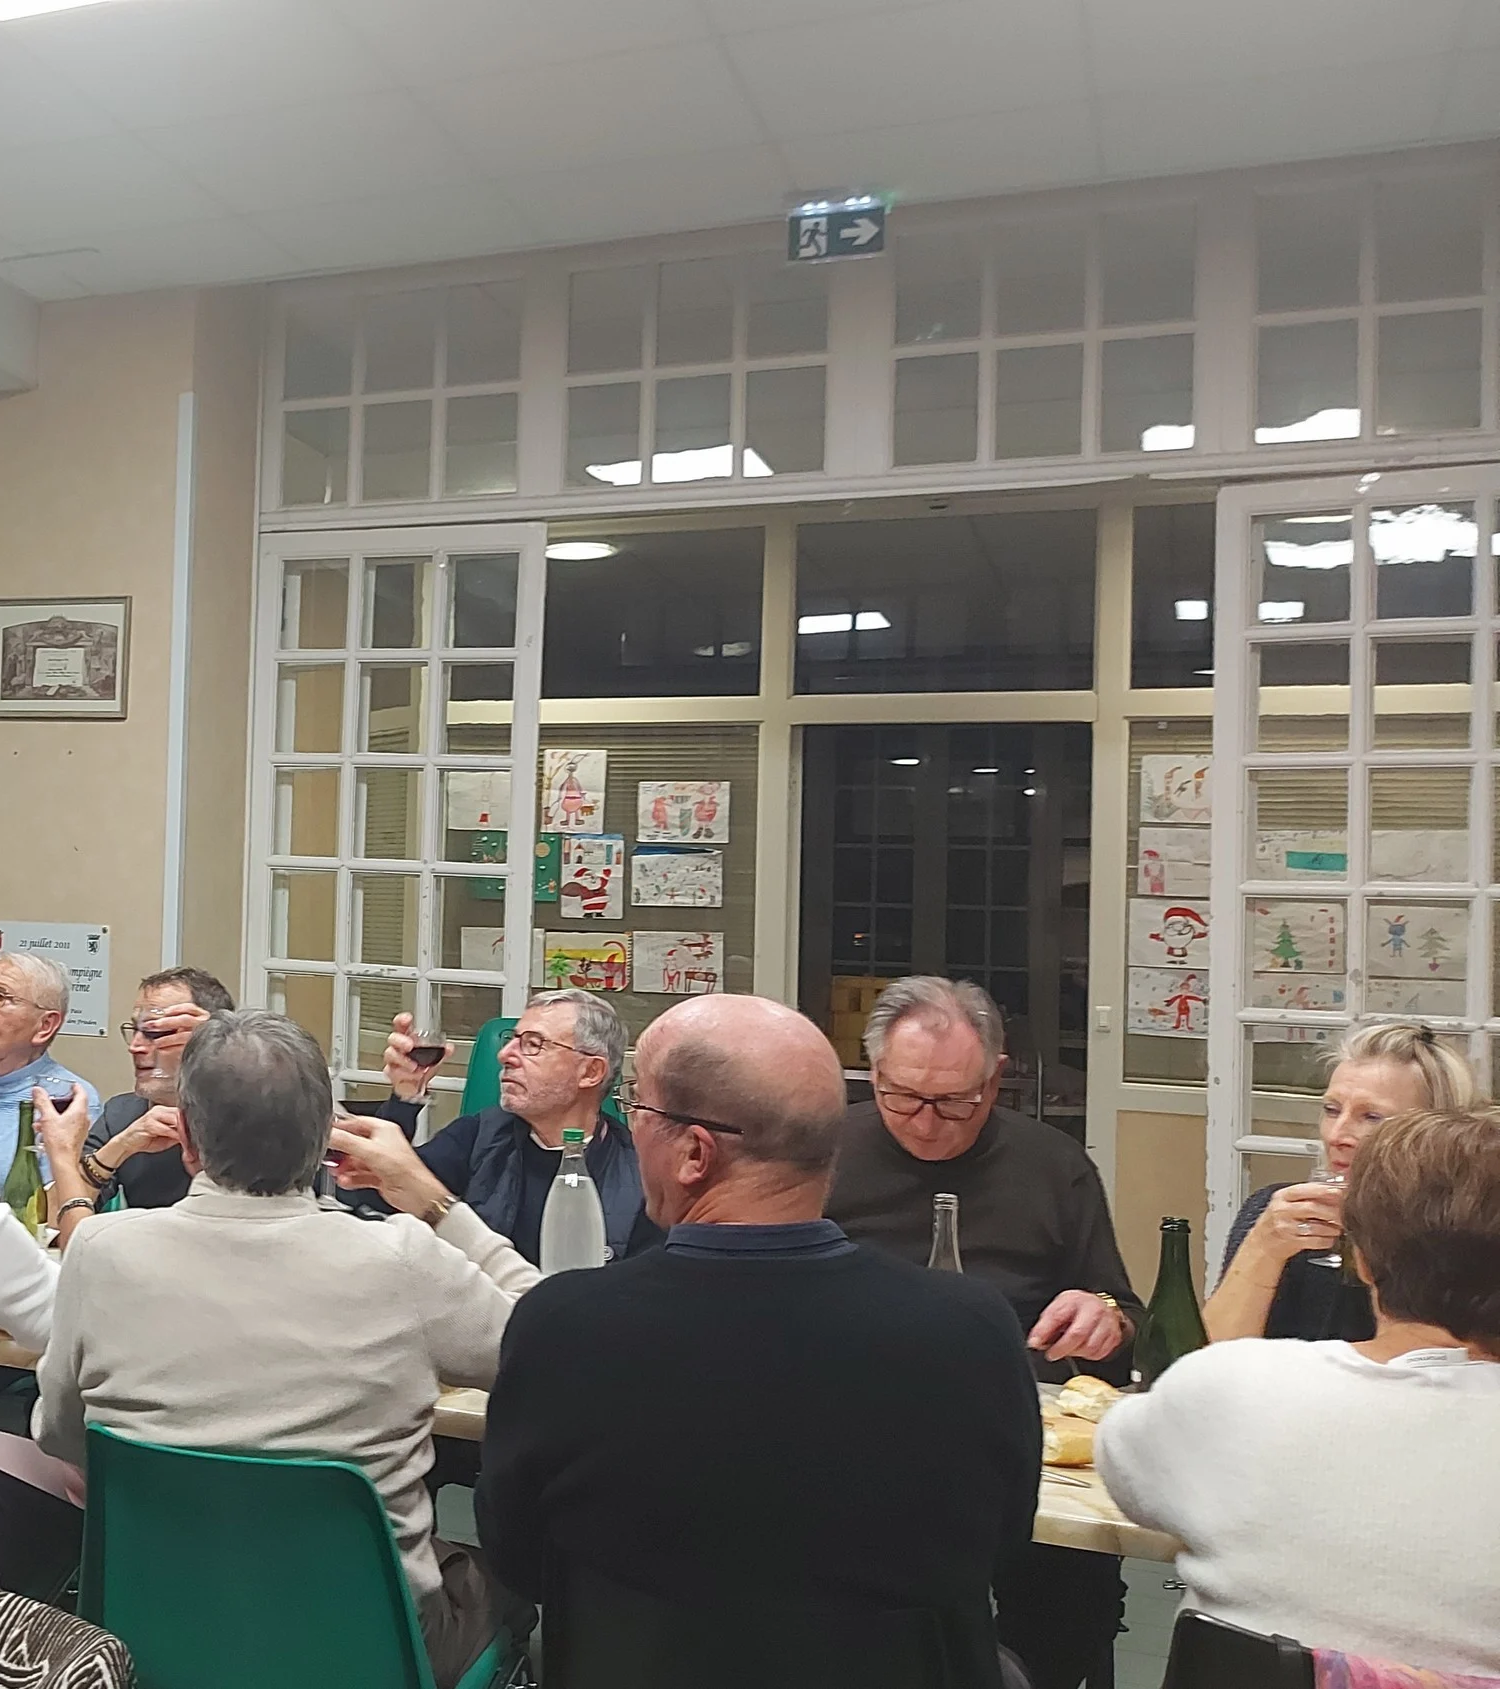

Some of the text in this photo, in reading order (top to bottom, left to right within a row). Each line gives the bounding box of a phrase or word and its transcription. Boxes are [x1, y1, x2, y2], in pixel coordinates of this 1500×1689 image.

[27, 937, 52, 950] juillet
[53, 941, 70, 949] 2011
[70, 966, 103, 981] mpiègne
